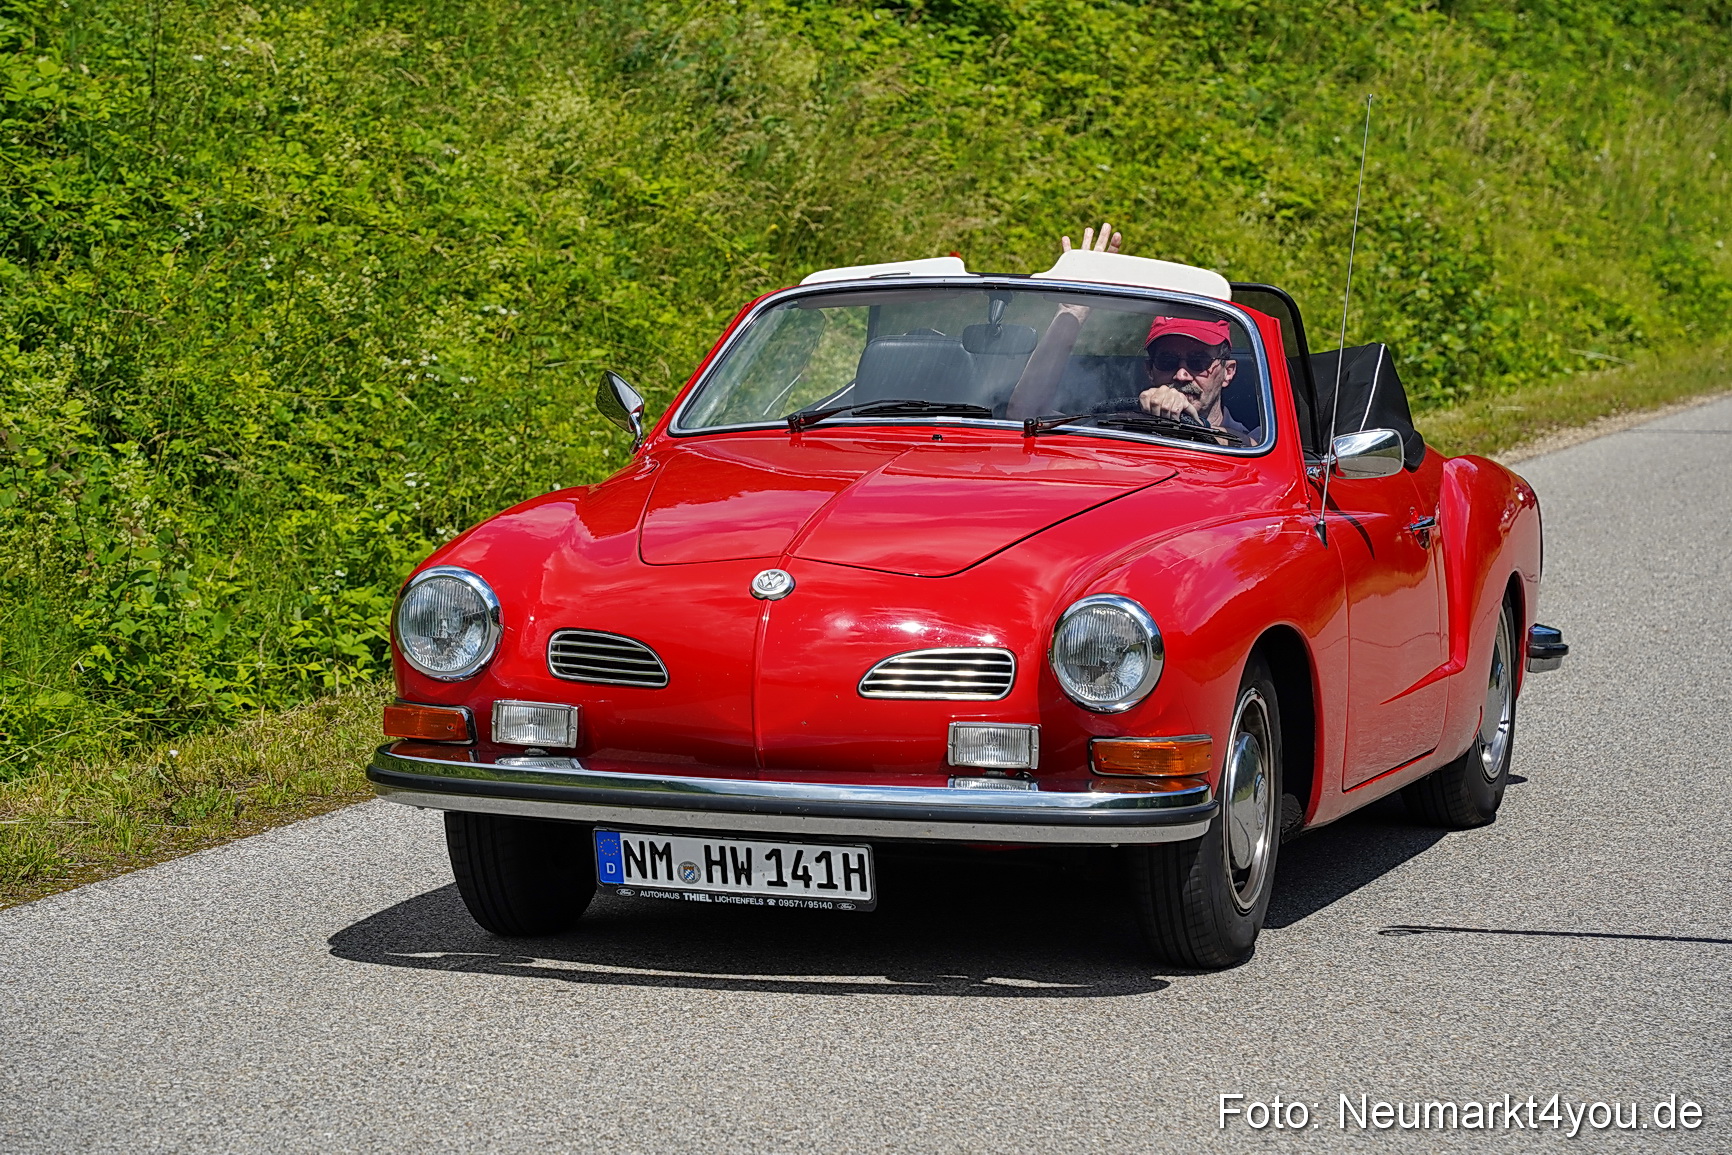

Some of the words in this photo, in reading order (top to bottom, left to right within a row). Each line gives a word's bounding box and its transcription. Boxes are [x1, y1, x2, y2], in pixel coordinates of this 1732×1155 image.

[756, 570, 786, 592] VW
[606, 863, 616, 874] D
[622, 839, 674, 881] NM
[704, 844, 753, 887] HW
[764, 848, 868, 893] 141H
[639, 890, 680, 900] AUTOHAUS
[682, 892, 712, 902] THIEL
[714, 895, 764, 906] LICHTENFELS
[778, 899, 833, 910] 09571/95140
